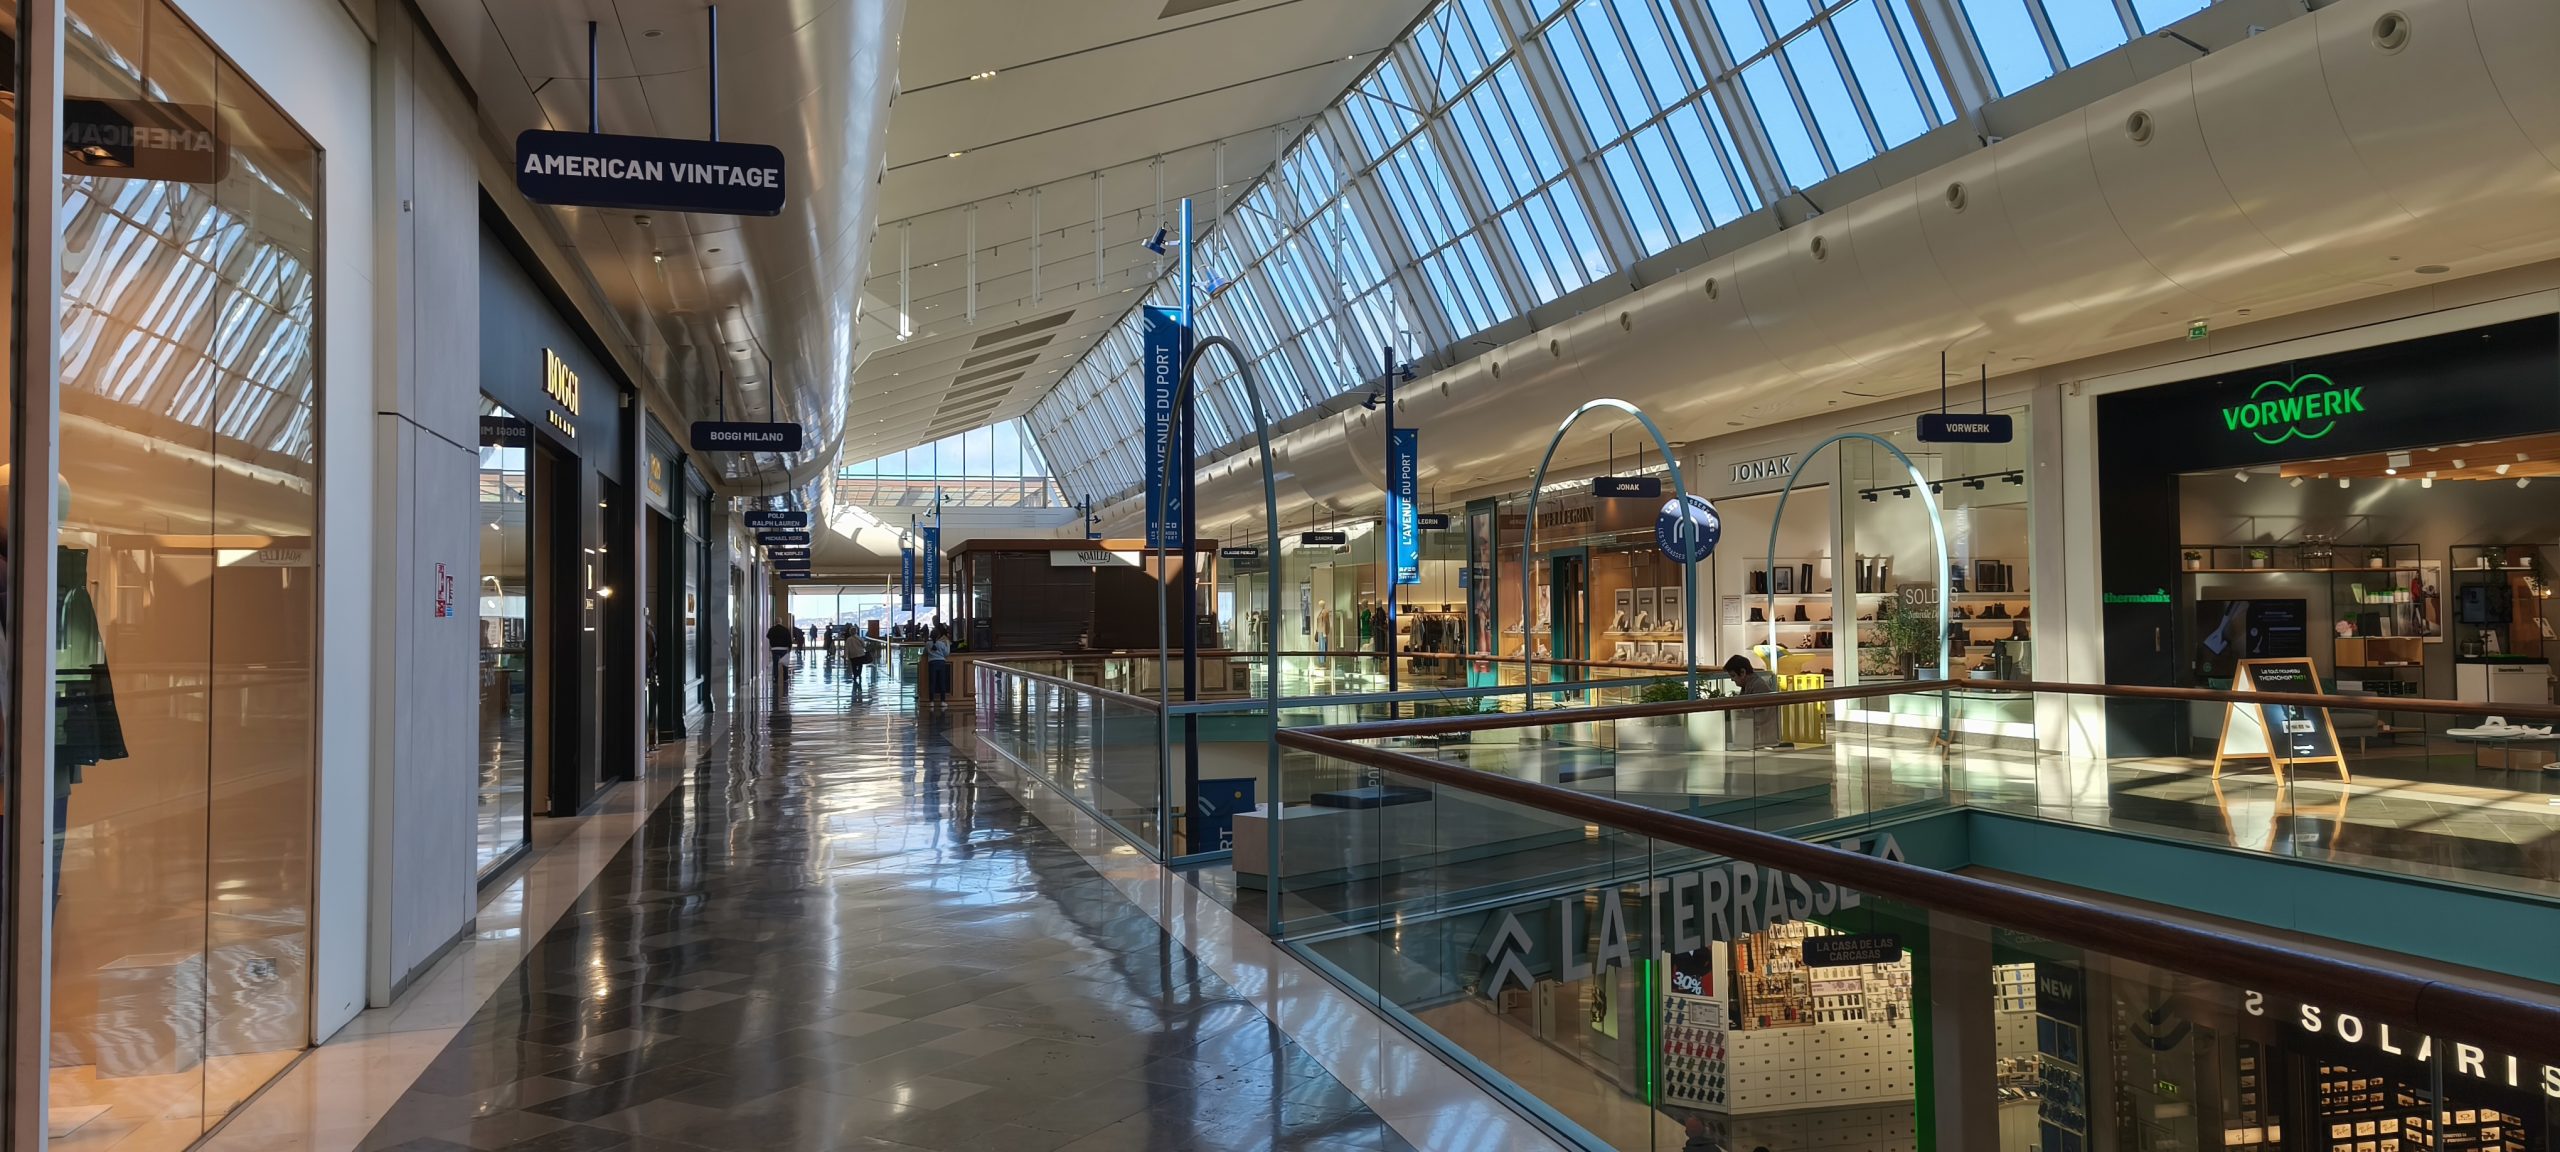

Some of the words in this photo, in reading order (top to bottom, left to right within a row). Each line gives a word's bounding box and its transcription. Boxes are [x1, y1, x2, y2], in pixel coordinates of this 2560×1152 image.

[524, 153, 662, 182] AMERICAN
[669, 162, 779, 189] VINTAGE
[1156, 344, 1169, 385] PORT
[545, 347, 579, 416] BOGGI
[1156, 389, 1170, 409] DU
[2222, 386, 2366, 431] VORWERK
[710, 431, 741, 441] BOGGI
[743, 431, 784, 442] MILANO
[1945, 422, 1990, 434] VORWERK
[1401, 453, 1411, 480] PORT
[1731, 456, 1792, 483] JONAK
[1402, 481, 1412, 495] DU
[1616, 483, 1640, 491] JONAK
[1402, 496, 1412, 546] L'AVENUE
[1077, 550, 1112, 563] NOAILLES
[1905, 587, 1959, 605] SOLDS
[1561, 886, 1631, 984] LA
[1816, 942, 1830, 952] LA
[1831, 940, 1858, 952] CASA
[1860, 939, 1873, 949] DE
[1873, 938, 1894, 948] LAS
[1829, 949, 1881, 961] CARCASAS
[2040, 976, 2073, 1001] NEW
